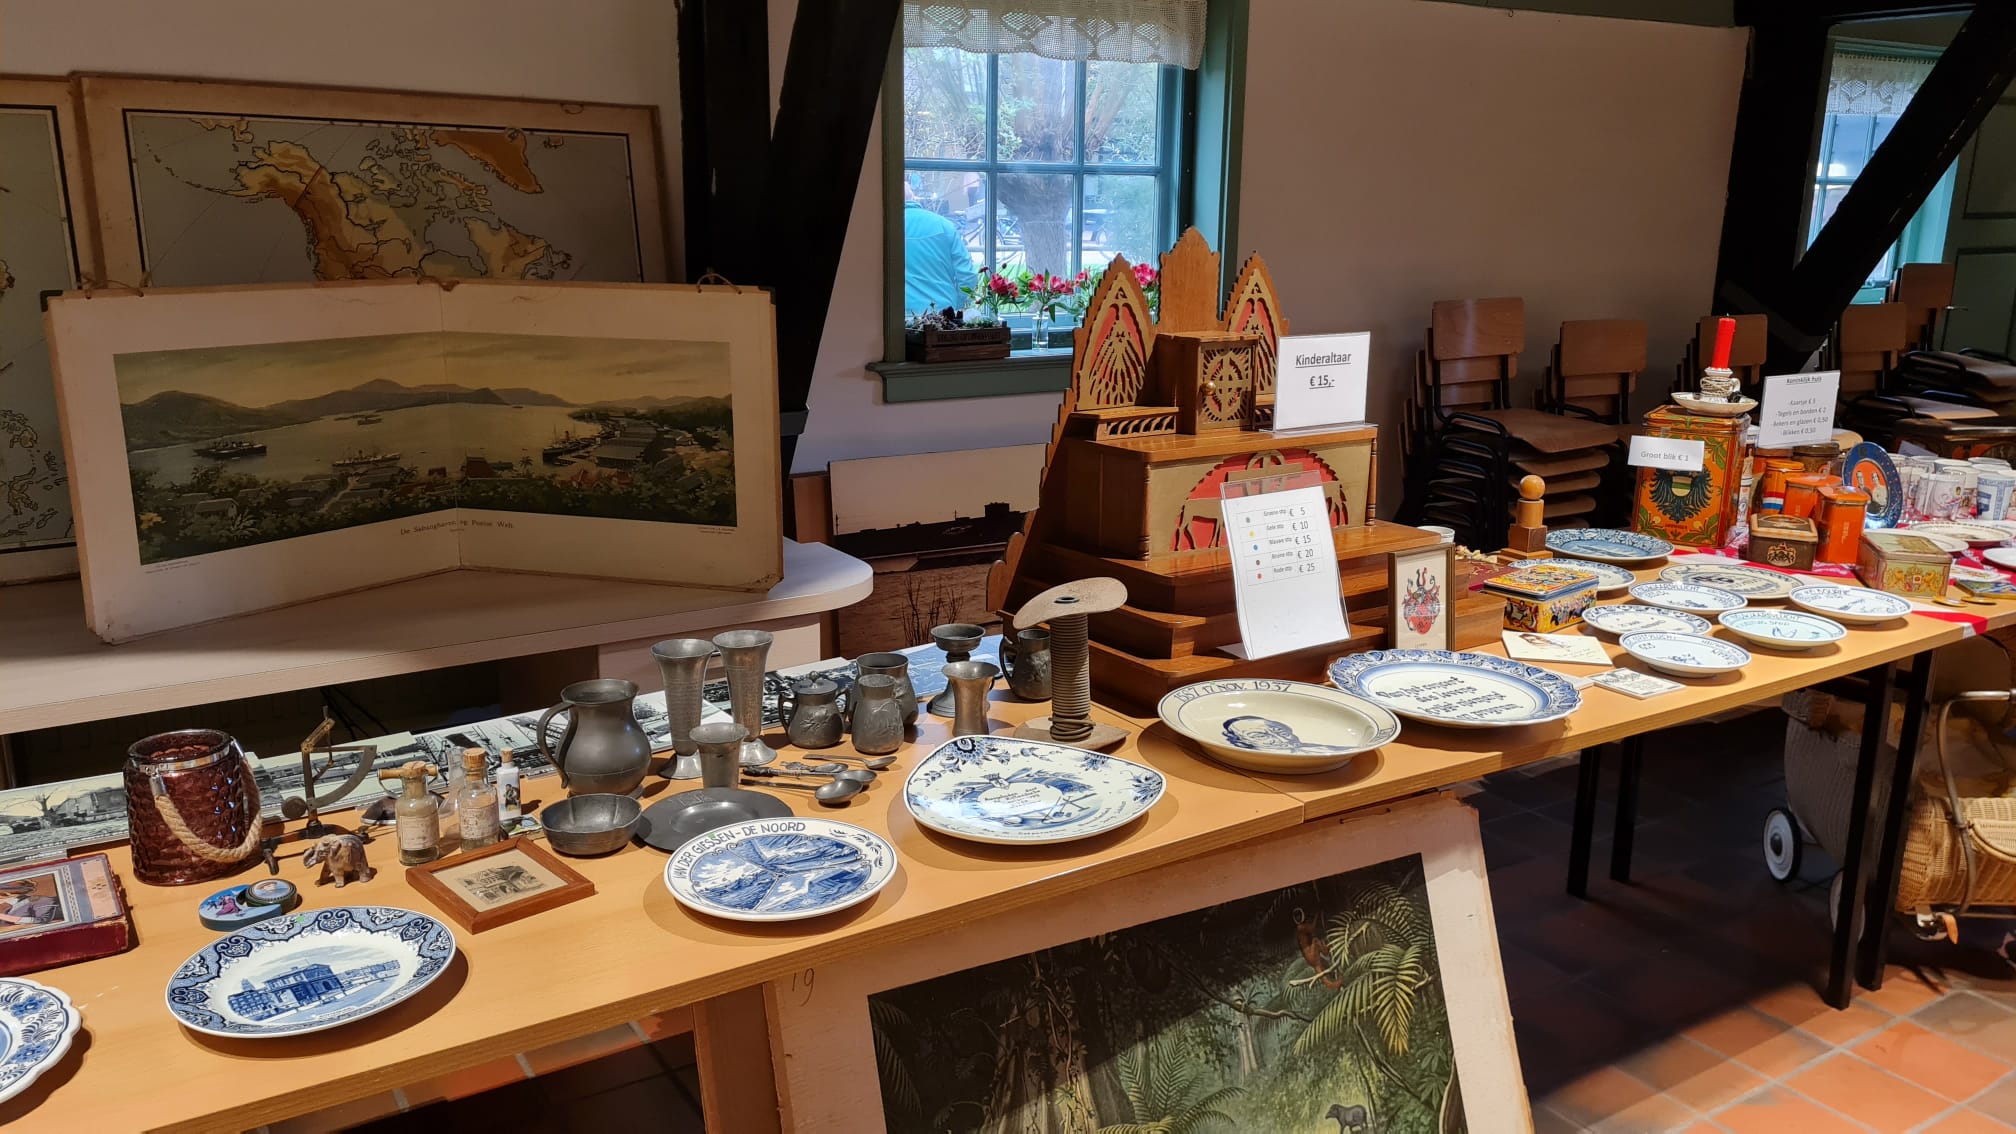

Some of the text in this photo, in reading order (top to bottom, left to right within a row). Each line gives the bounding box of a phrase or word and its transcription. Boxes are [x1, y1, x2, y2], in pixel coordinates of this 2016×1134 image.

[1295, 352, 1352, 367] Kinderaltaar
[1309, 374, 1335, 388] € 15,-
[1640, 450, 1661, 459] Groot
[1663, 452, 1676, 460] blik
[1300, 506, 1306, 516] 5
[1300, 520, 1309, 530] 10
[1303, 534, 1312, 544] 15
[1305, 548, 1314, 558] 20
[1307, 562, 1316, 572] 25
[1253, 679, 1293, 693] 1937
[679, 850, 697, 867] DER
[760, 821, 807, 834] NOORD
[791, 967, 815, 1008] 19
